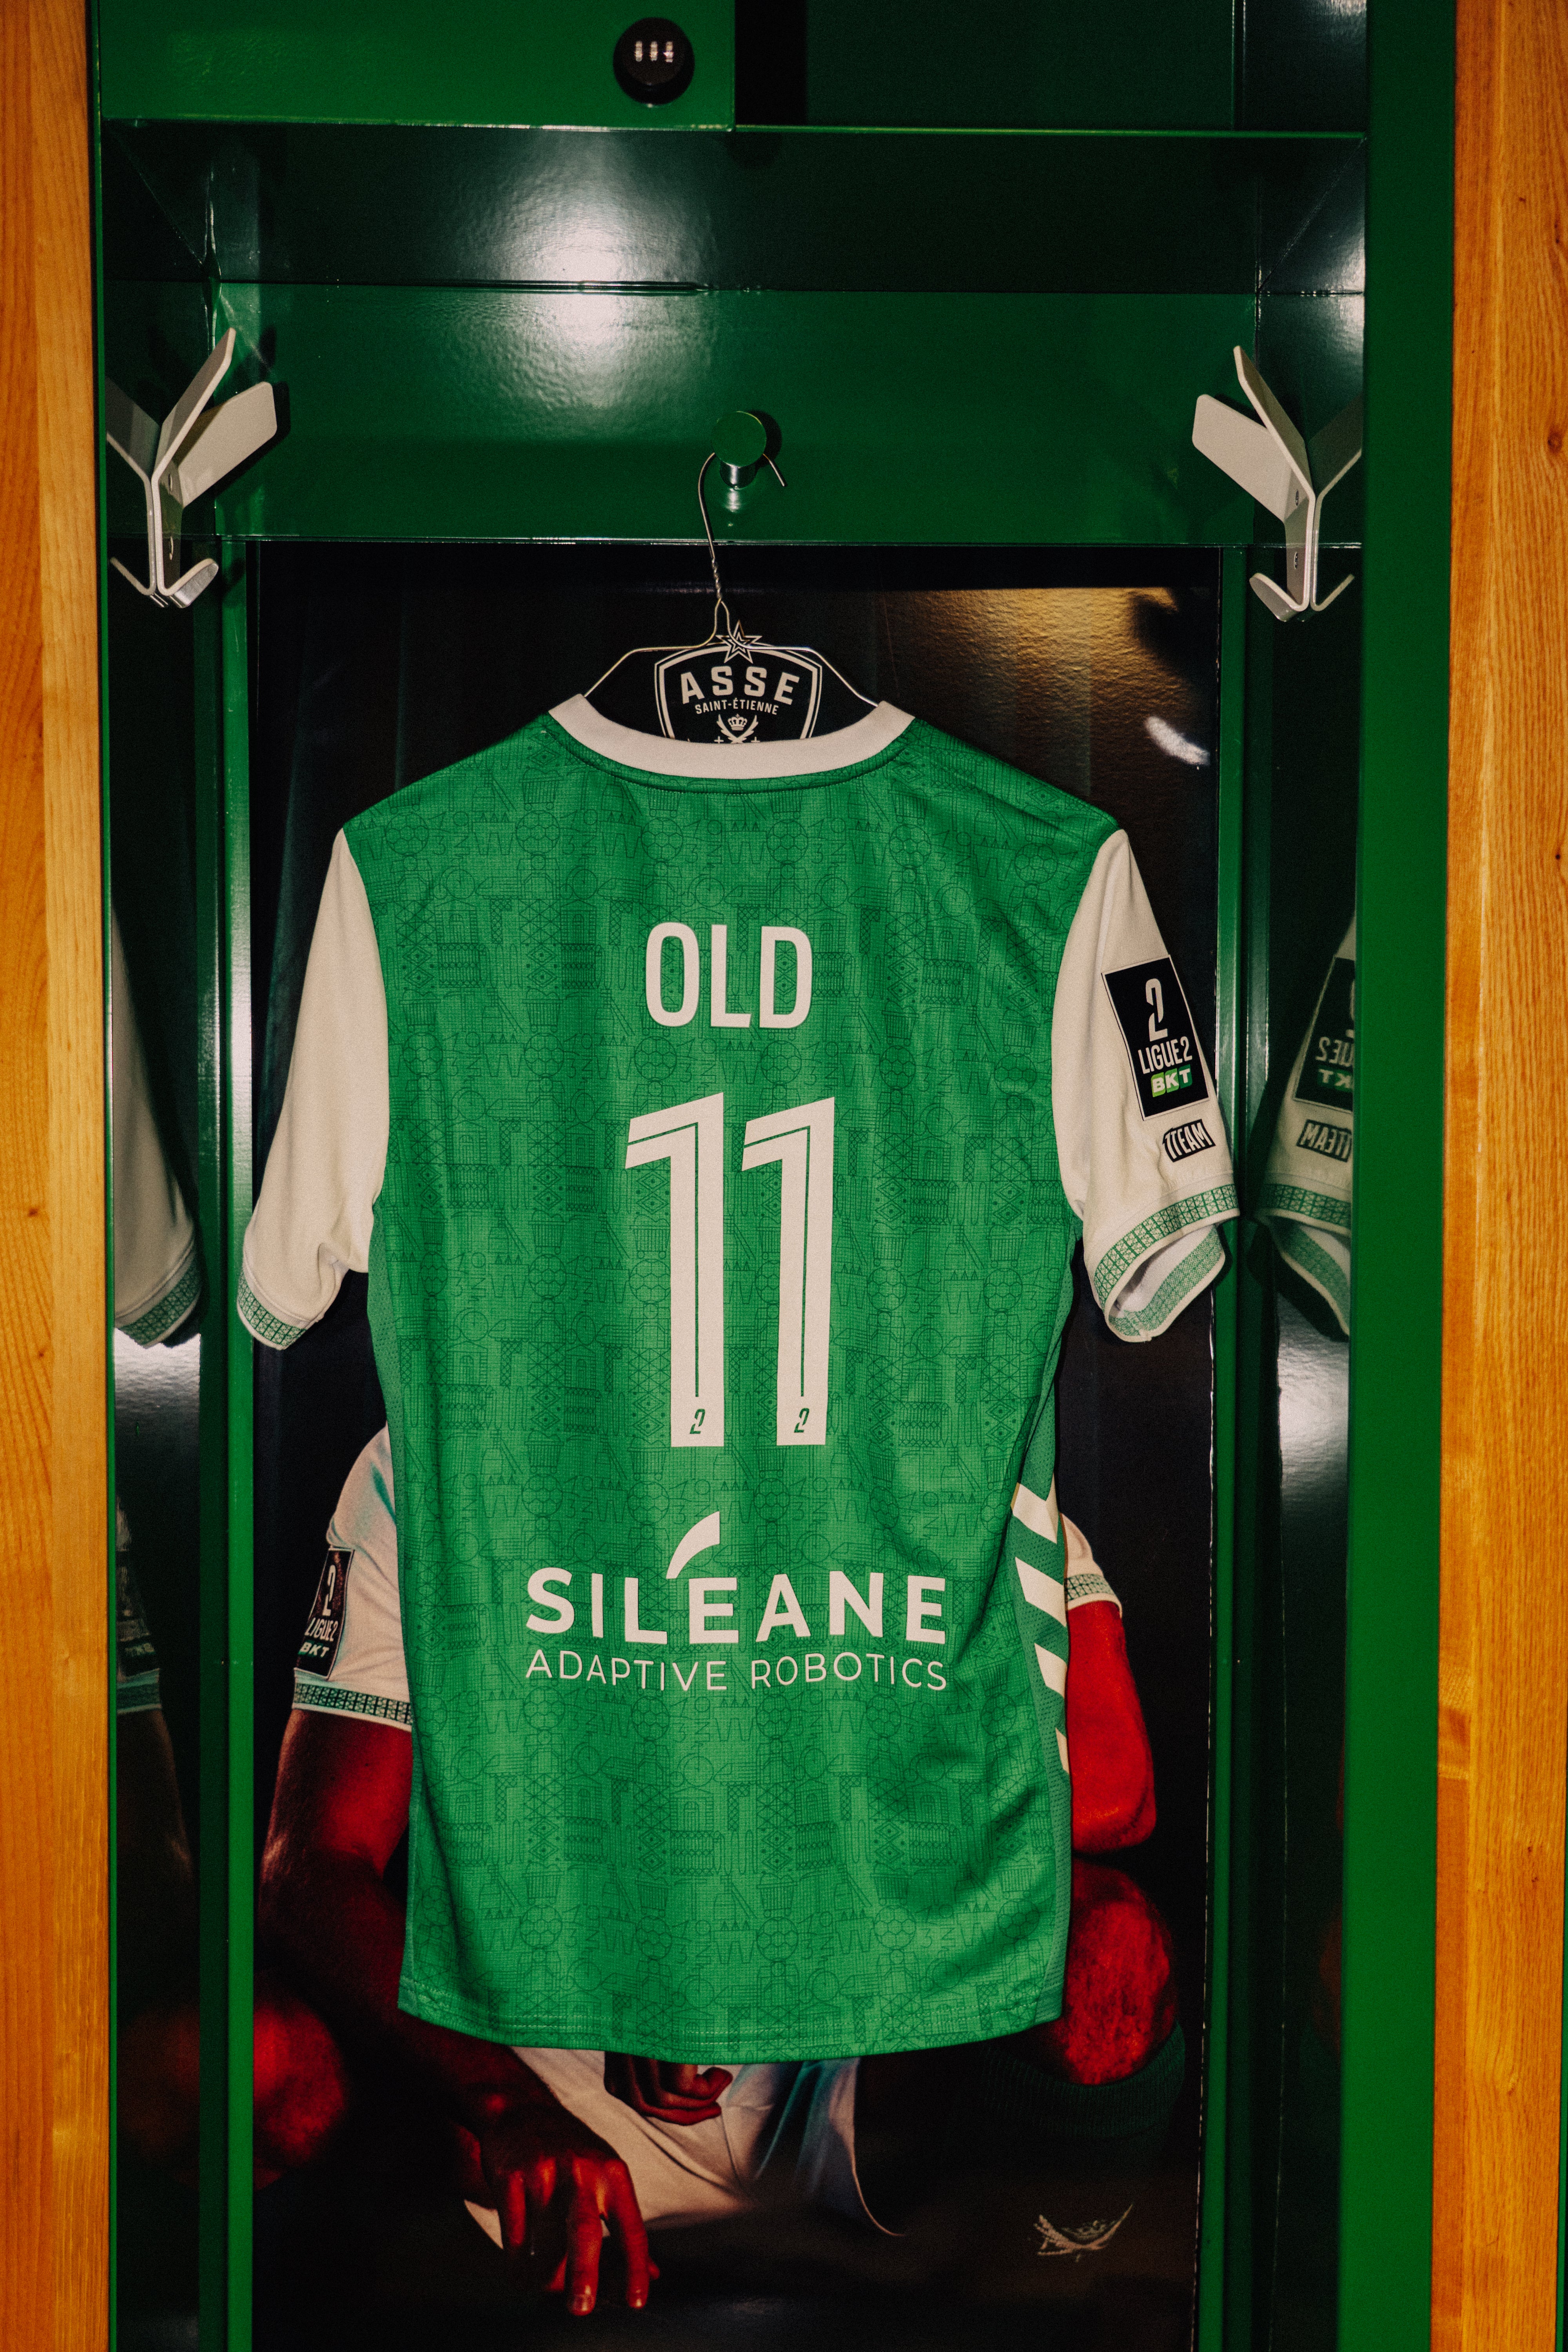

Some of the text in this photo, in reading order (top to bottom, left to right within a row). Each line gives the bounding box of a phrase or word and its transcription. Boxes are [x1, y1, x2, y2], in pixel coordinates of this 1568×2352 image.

[681, 666, 800, 705] ASSE
[695, 698, 779, 715] SAINT-ÉTIENNE
[645, 922, 813, 1029] OLD
[1145, 978, 1168, 1042] 2
[1152, 1068, 1190, 1093] BKT
[625, 1092, 835, 1447] 11
[323, 1564, 336, 1616] 2
[300, 1642, 329, 1657] BKT
[525, 1649, 947, 1691] ADAPTIVE ROBOTICS
